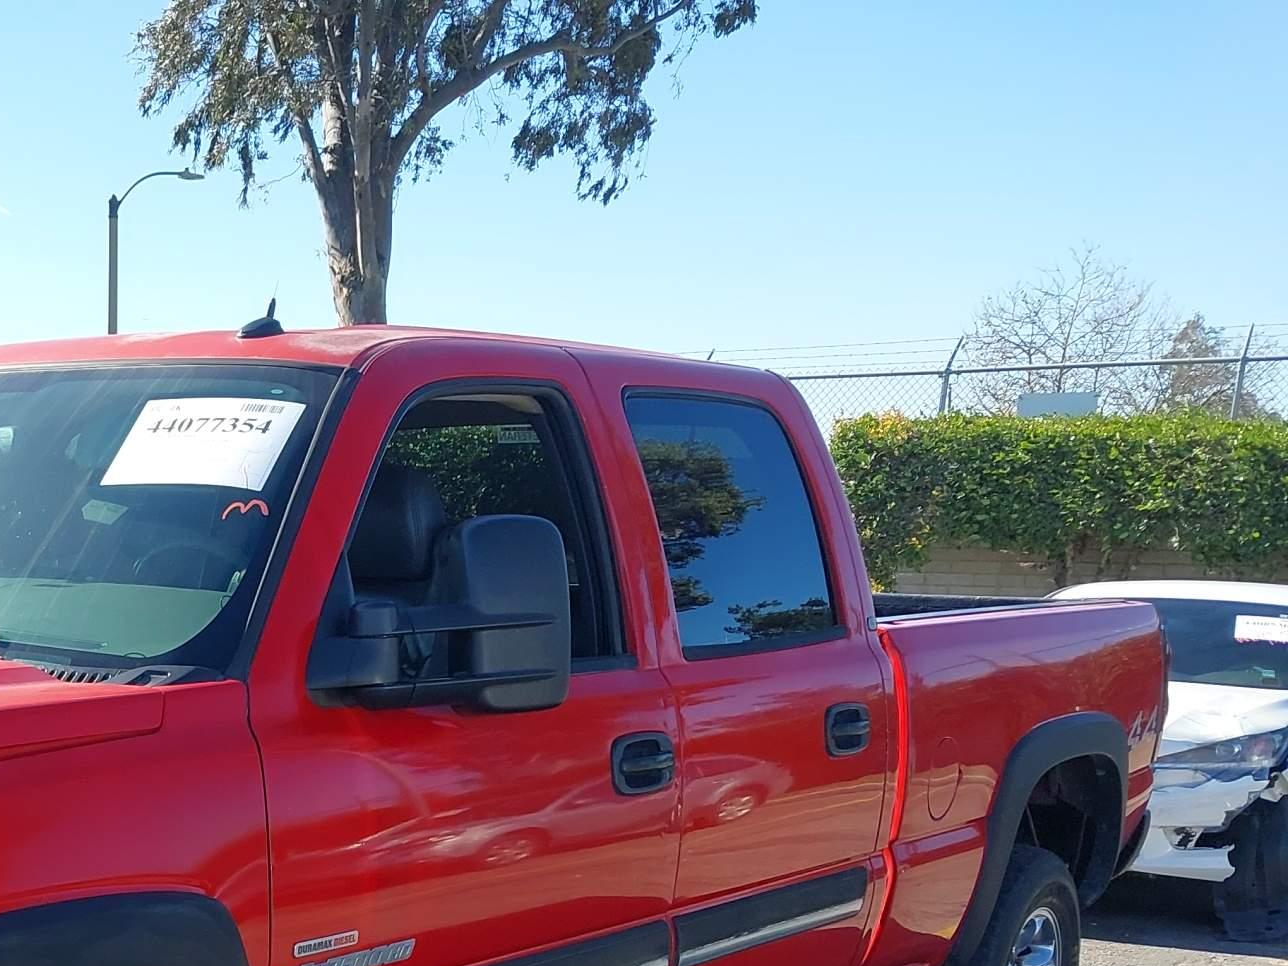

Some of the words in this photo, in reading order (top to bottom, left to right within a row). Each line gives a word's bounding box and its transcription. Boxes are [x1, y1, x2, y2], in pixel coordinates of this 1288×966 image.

[146, 417, 273, 434] 44077354
[297, 938, 334, 955] DURAMAX
[333, 933, 357, 948] DIESEL
